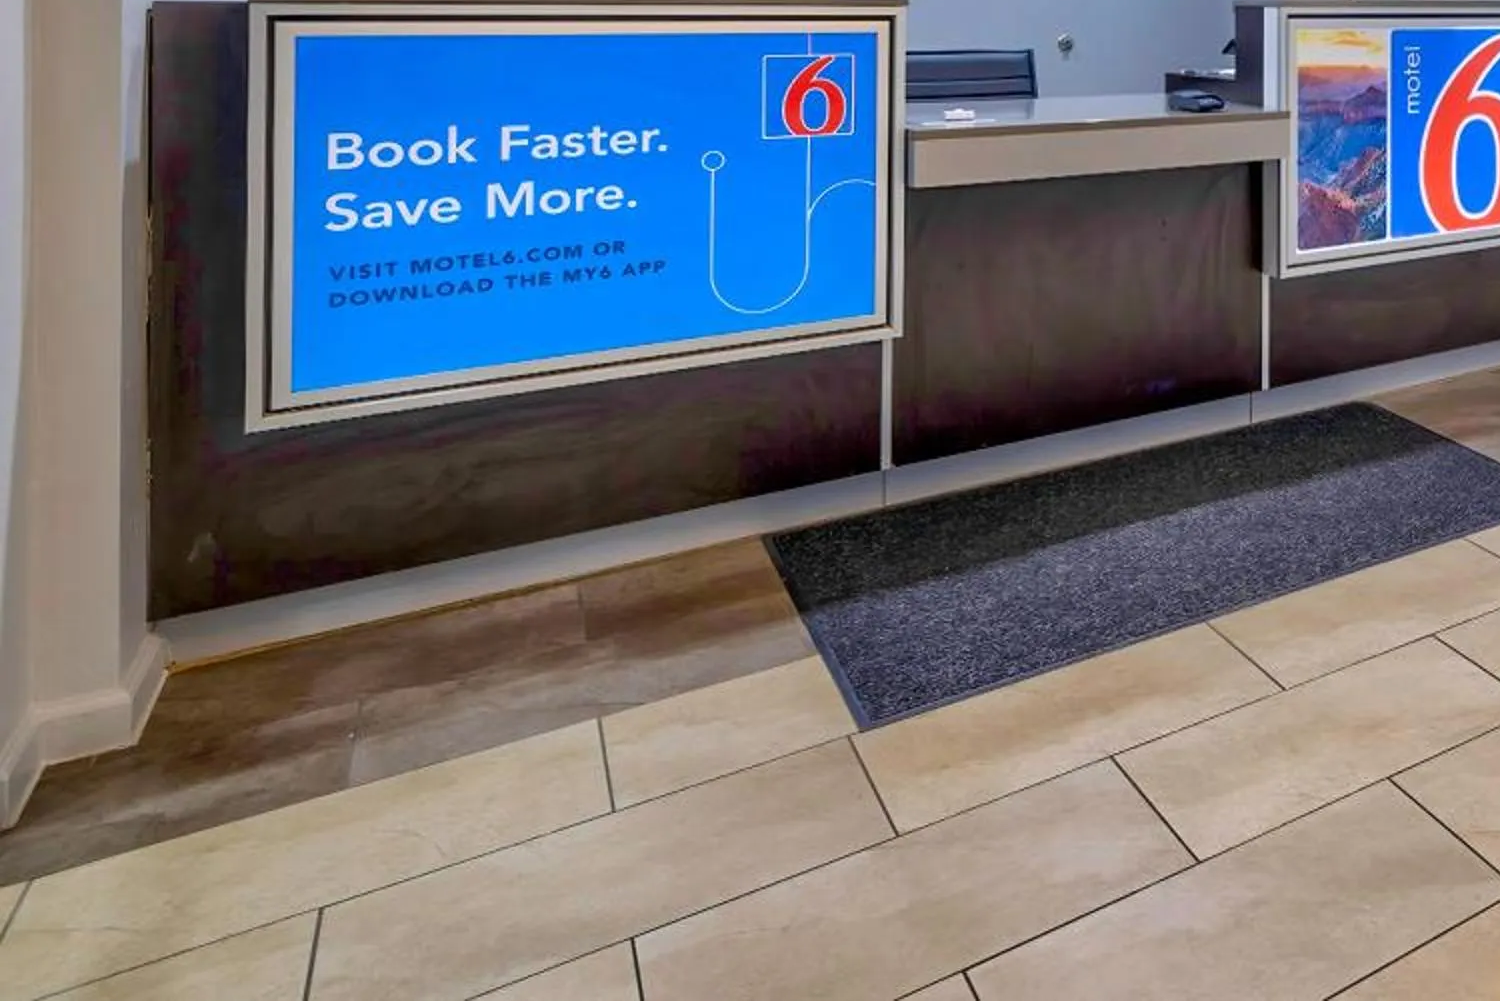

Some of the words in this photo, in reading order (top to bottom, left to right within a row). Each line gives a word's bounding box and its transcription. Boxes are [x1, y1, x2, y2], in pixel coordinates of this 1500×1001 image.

[782, 54, 847, 136] 6
[1404, 45, 1421, 114] motel
[327, 125, 478, 170] Book
[500, 124, 668, 161] Faster.
[324, 191, 462, 231] Save
[486, 180, 638, 219] More.
[328, 277, 493, 309] DOWNLOAD
[505, 272, 552, 290] THE
[563, 265, 612, 284] MY6
[623, 259, 666, 277] APP
[329, 260, 399, 281] VISIT
[410, 244, 583, 275] MOTEL6.COM
[593, 240, 625, 257] OR
